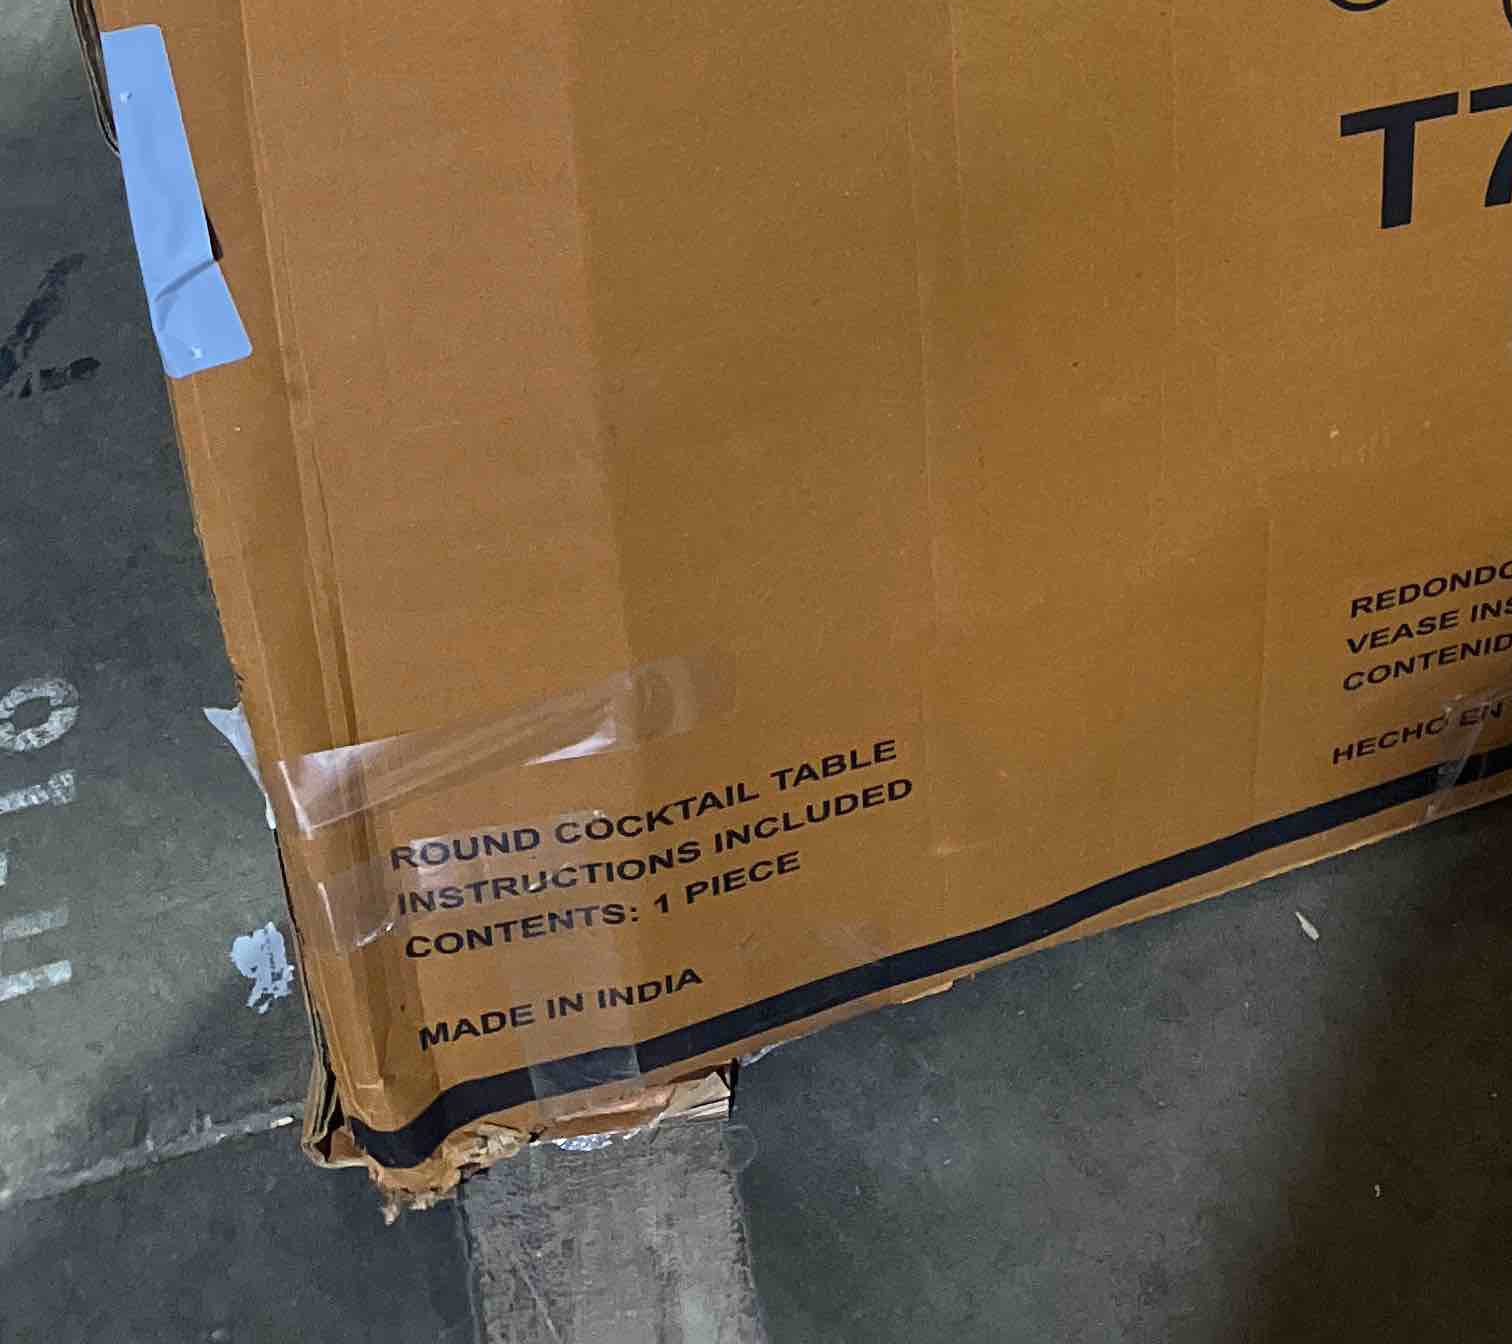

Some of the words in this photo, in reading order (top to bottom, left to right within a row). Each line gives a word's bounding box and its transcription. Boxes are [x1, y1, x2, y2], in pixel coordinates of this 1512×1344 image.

[1346, 610, 1459, 654] VEASE
[1332, 717, 1449, 765] HECHO
[1460, 700, 1502, 728] EN
[391, 828, 540, 872] ROUND
[556, 782, 760, 845] COCKTAIL
[770, 739, 898, 792] TABLE
[398, 840, 701, 915] INSTRUCTIONS
[715, 778, 913, 853] INCLUDED
[405, 903, 640, 960] CONTENTS:
[654, 893, 670, 913] 1
[686, 851, 802, 905] PIECE
[419, 1003, 533, 1051] MADE
[547, 992, 584, 1020] IN
[597, 967, 704, 1009] INDIA
